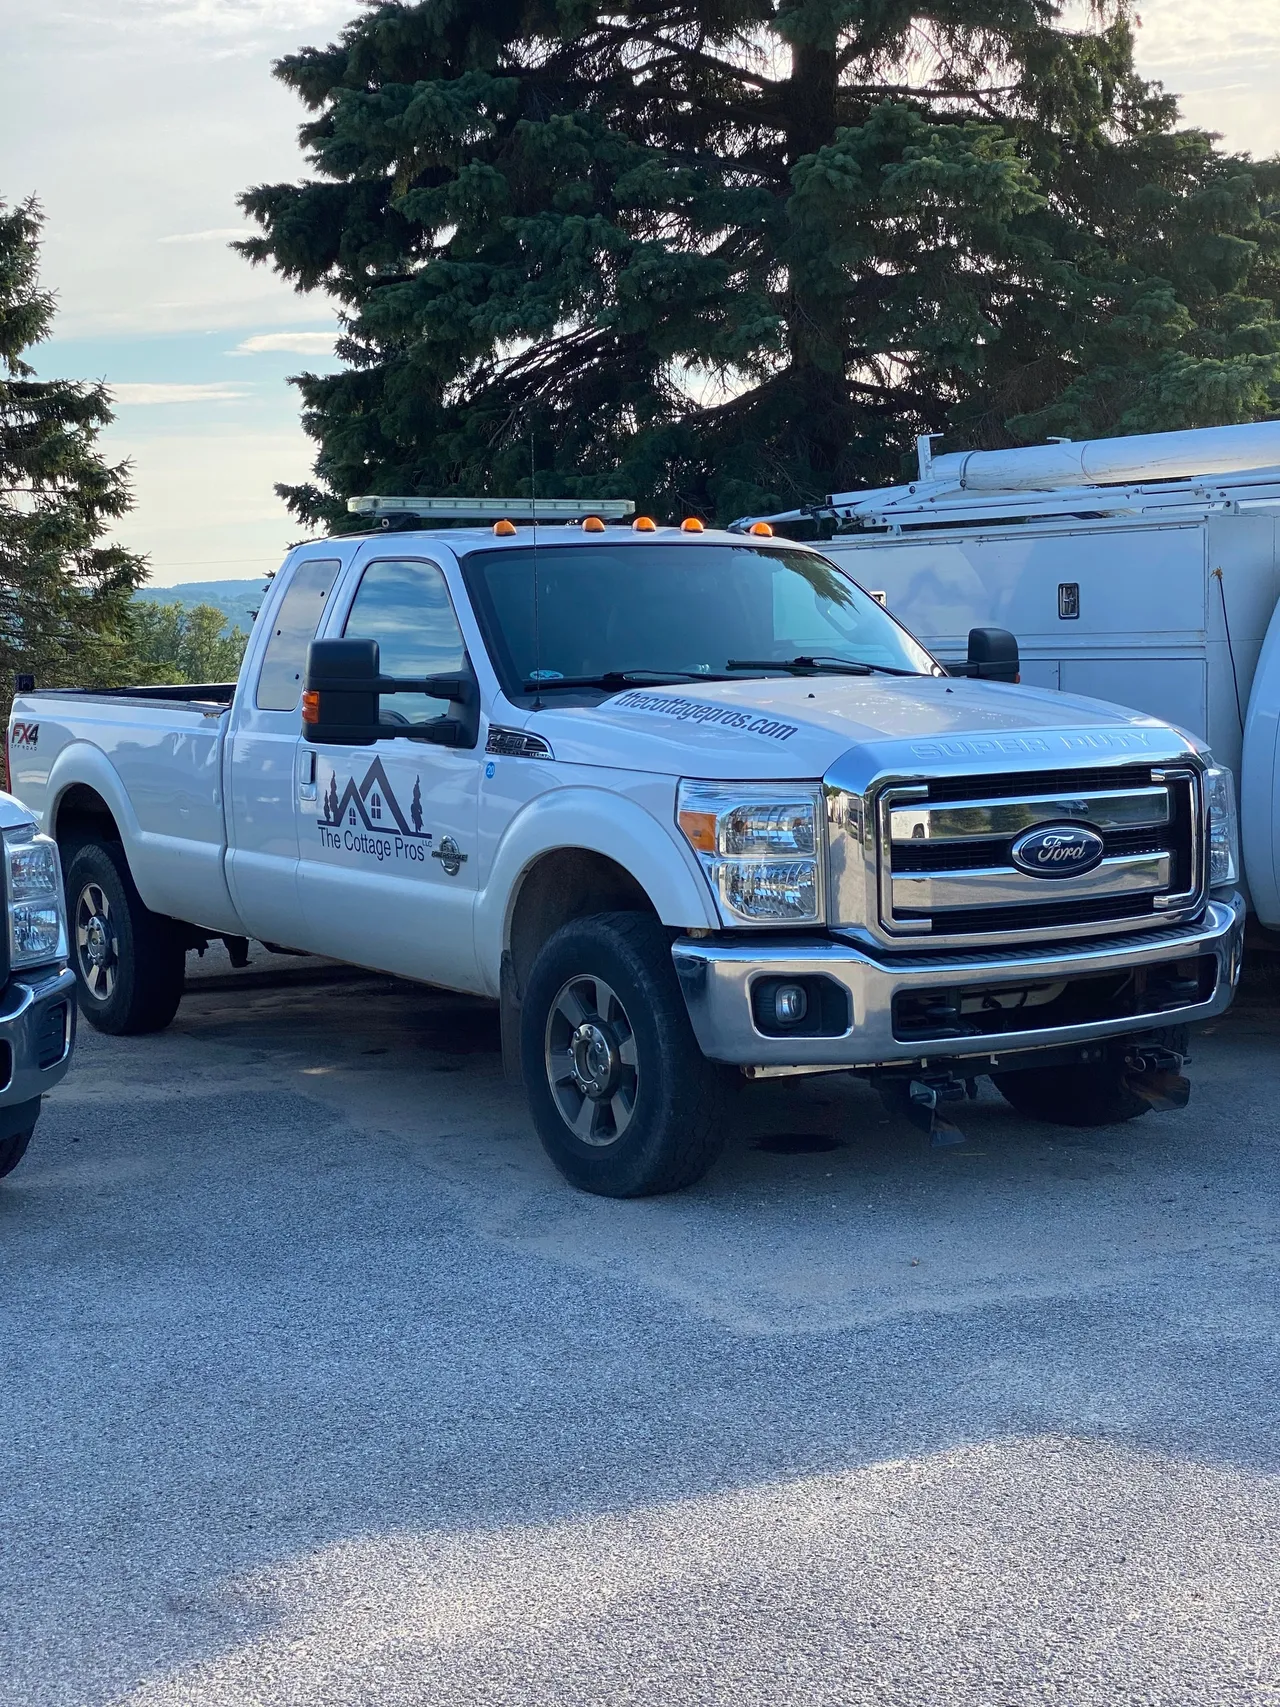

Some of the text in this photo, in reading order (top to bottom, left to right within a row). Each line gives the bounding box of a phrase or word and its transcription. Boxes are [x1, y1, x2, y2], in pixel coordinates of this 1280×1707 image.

[614, 691, 799, 741] thecottagepros.com
[11, 722, 40, 745] FX4
[910, 732, 1151, 759] SUPER DUTY
[318, 826, 341, 849] The
[344, 830, 391, 861] Cottage
[394, 837, 425, 862] Pros
[1037, 835, 1086, 862] Ford
